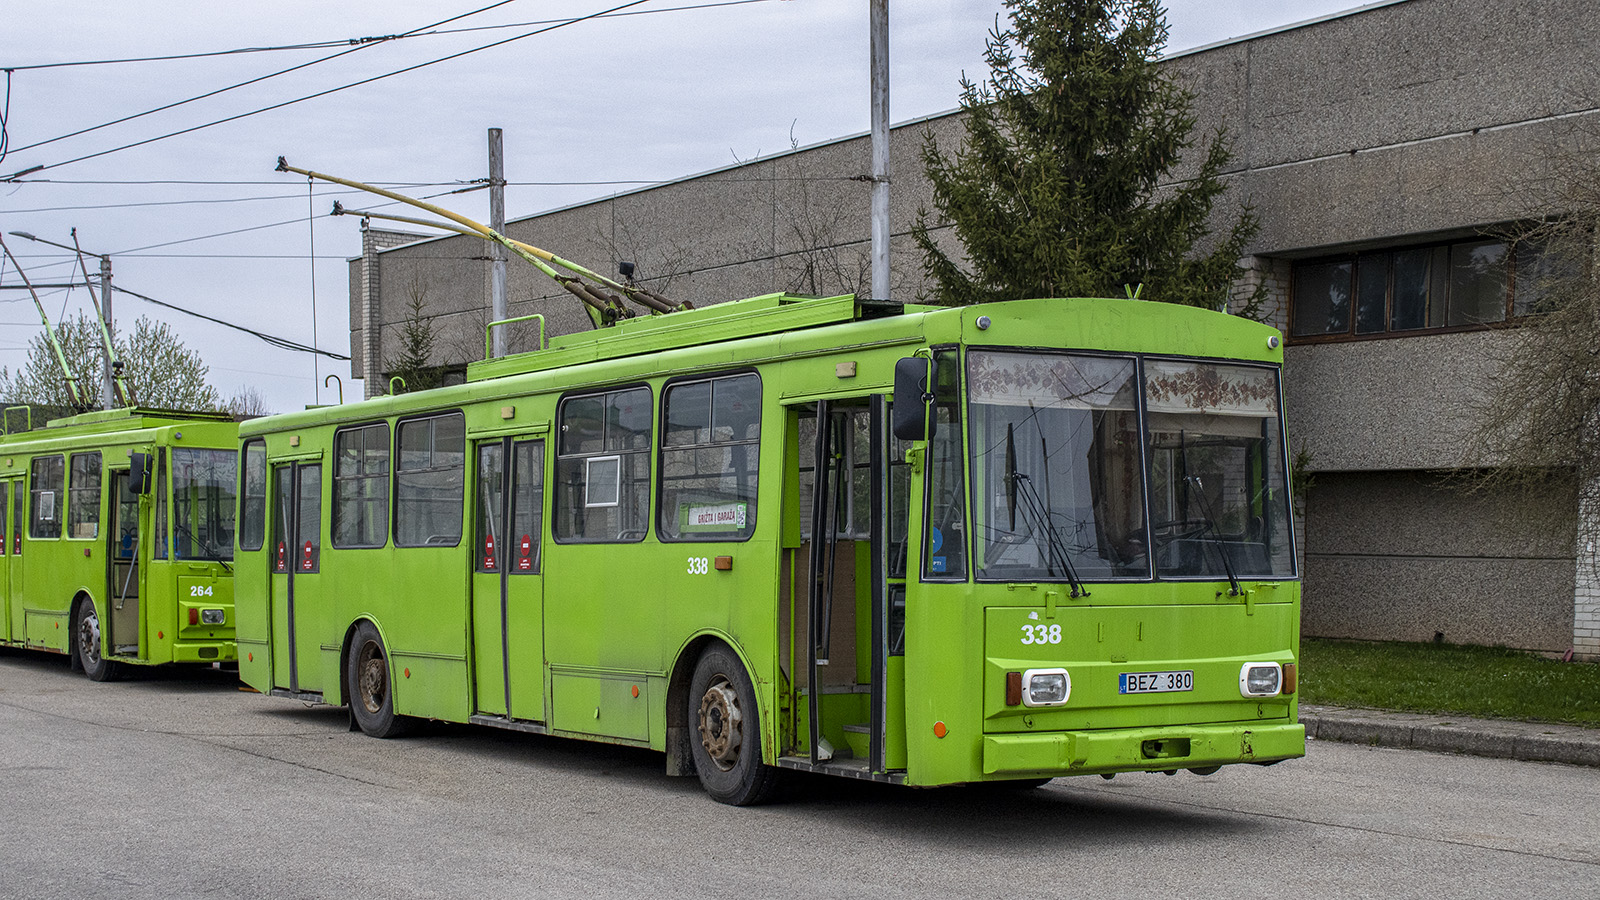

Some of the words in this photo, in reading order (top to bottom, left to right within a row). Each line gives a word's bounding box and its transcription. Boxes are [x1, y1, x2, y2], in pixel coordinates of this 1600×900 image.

[687, 557, 708, 574] 338
[190, 585, 213, 596] 264
[1020, 624, 1062, 645] 338
[1128, 674, 1158, 691] BEZ
[1167, 673, 1191, 689] 380
